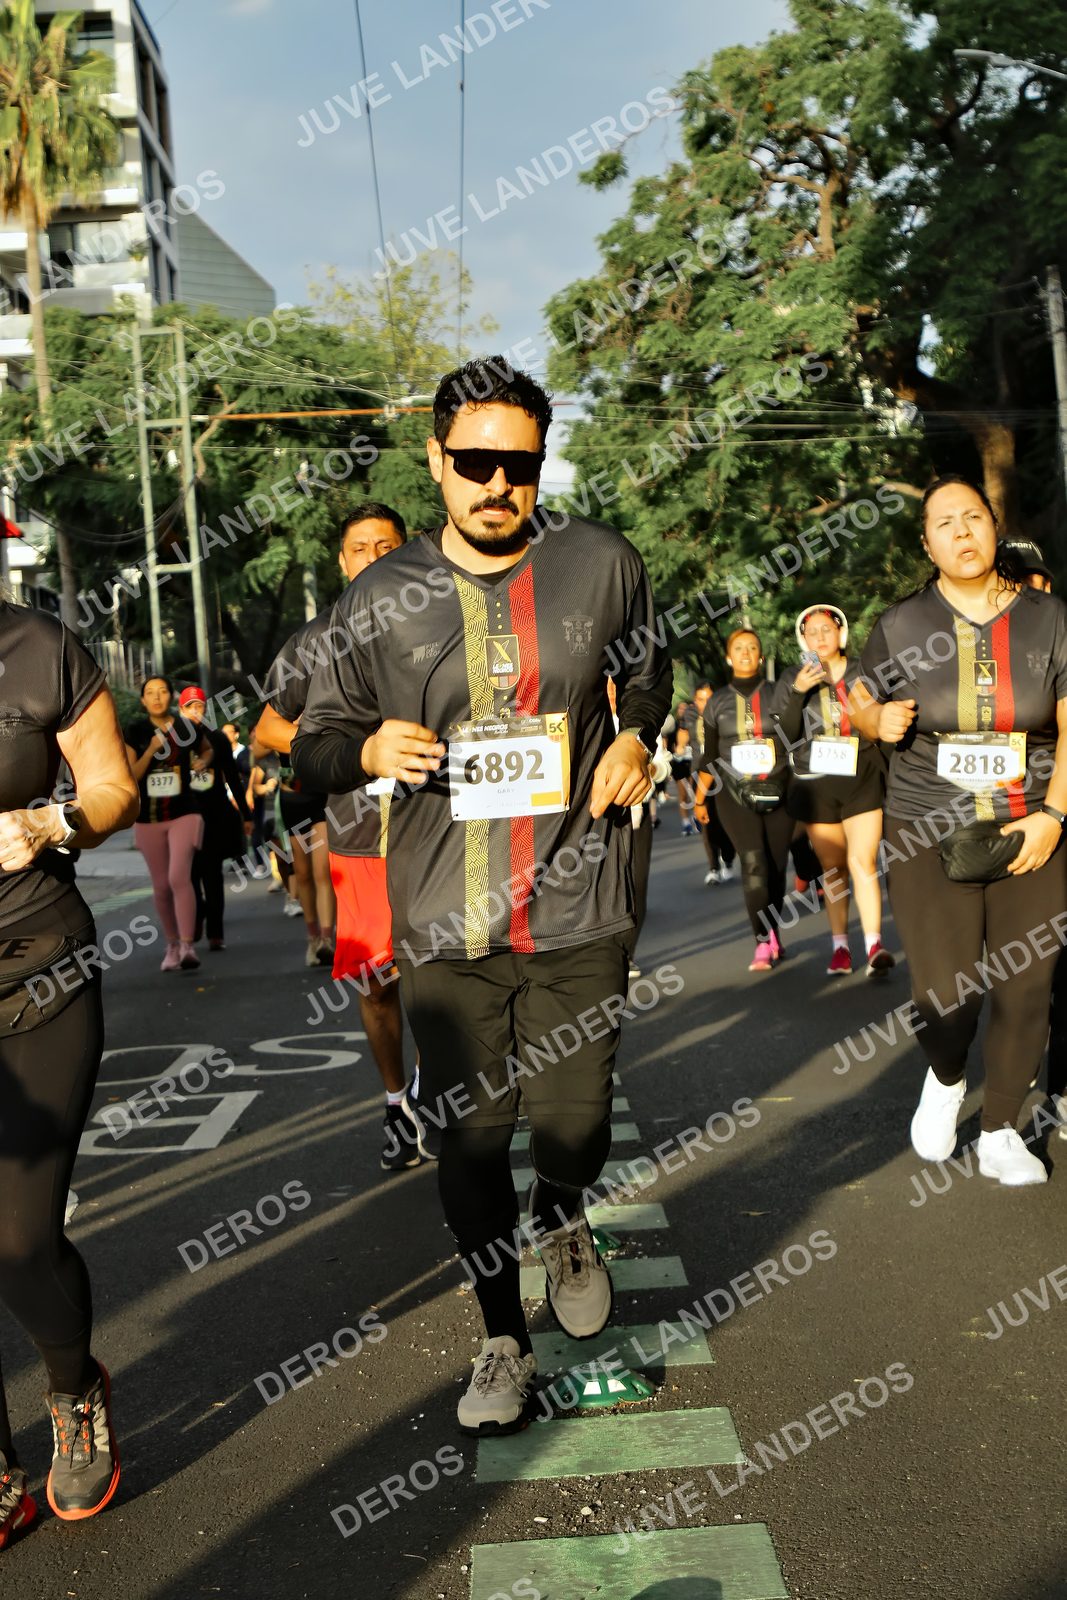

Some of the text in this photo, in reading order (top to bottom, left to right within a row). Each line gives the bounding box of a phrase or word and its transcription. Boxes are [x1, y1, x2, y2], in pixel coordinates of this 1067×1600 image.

[1006, 542, 1032, 550] SPORT
[549, 722, 564, 733] 5K
[464, 749, 544, 785] 6892
[950, 752, 1006, 775] 2818
[151, 775, 174, 786] 3377
